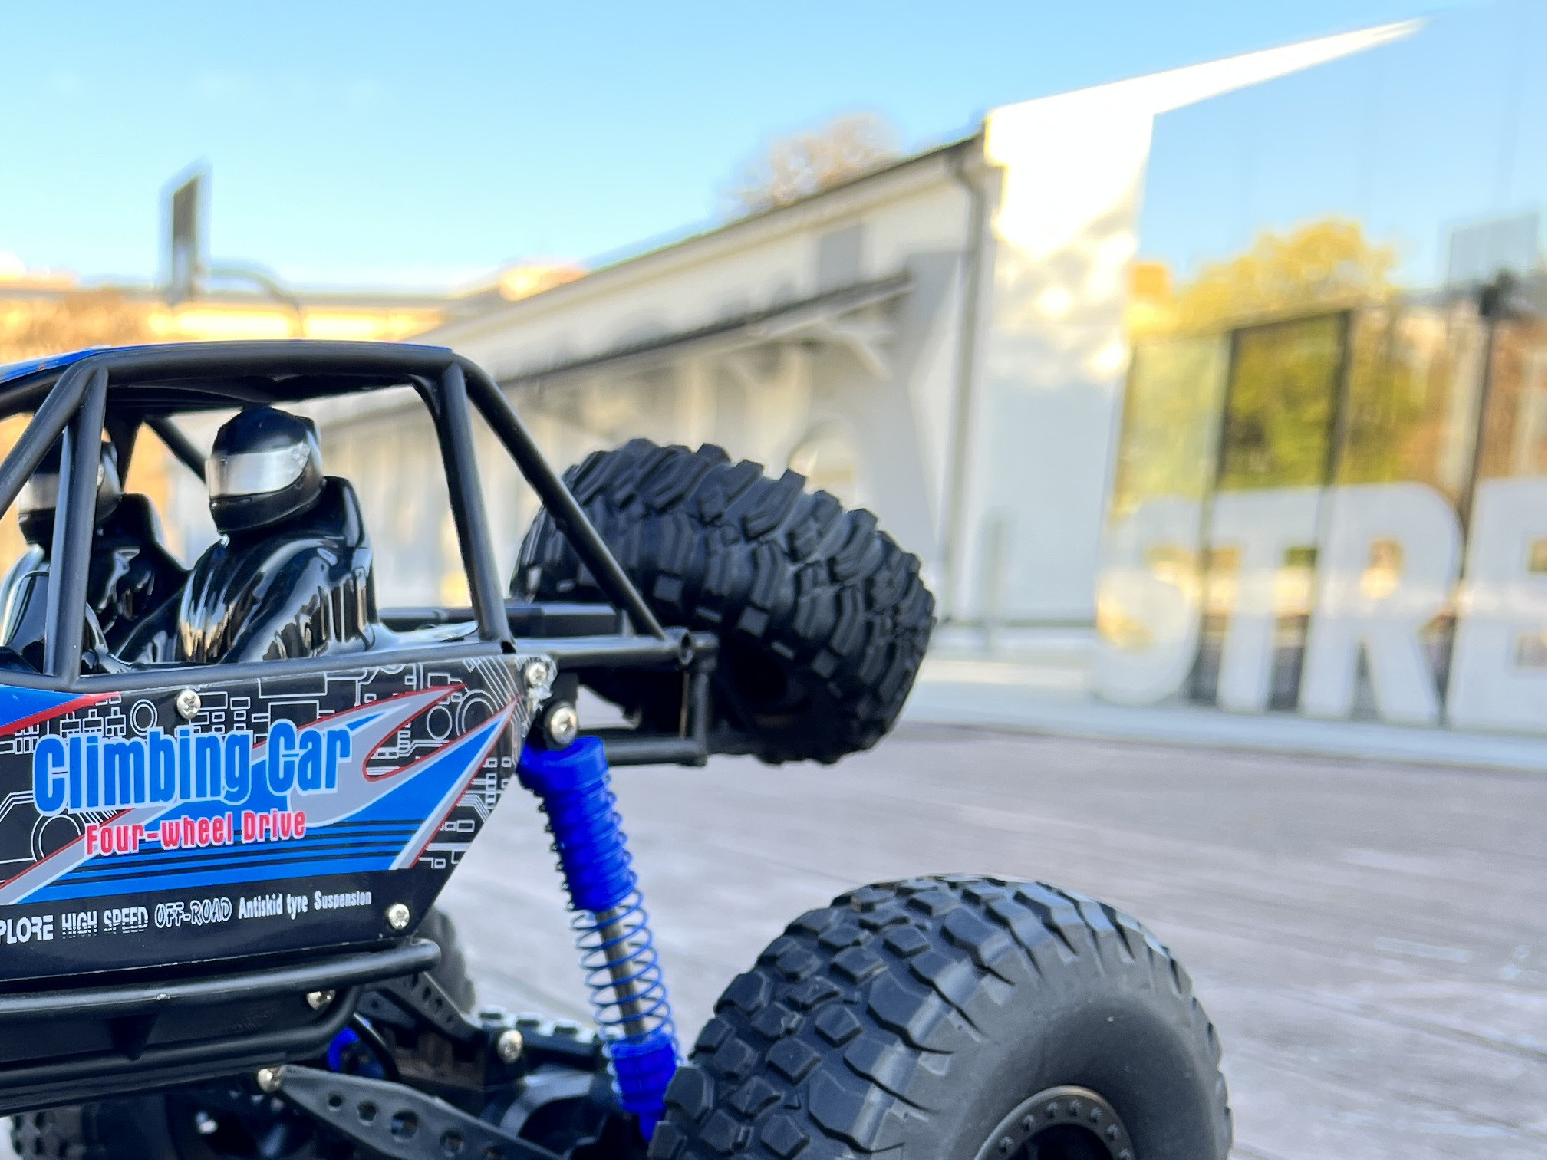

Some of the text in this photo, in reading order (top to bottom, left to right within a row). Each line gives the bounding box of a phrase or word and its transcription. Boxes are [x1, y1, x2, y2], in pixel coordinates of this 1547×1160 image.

[33, 719, 352, 815] Climbing Car
[85, 808, 306, 855] Four-wheel Drive
[61, 910, 98, 939] HIGH
[103, 906, 149, 934] SPEED
[154, 896, 233, 928] OFF-ROAD
[238, 893, 283, 920] Antiskid
[287, 893, 309, 920] tyre
